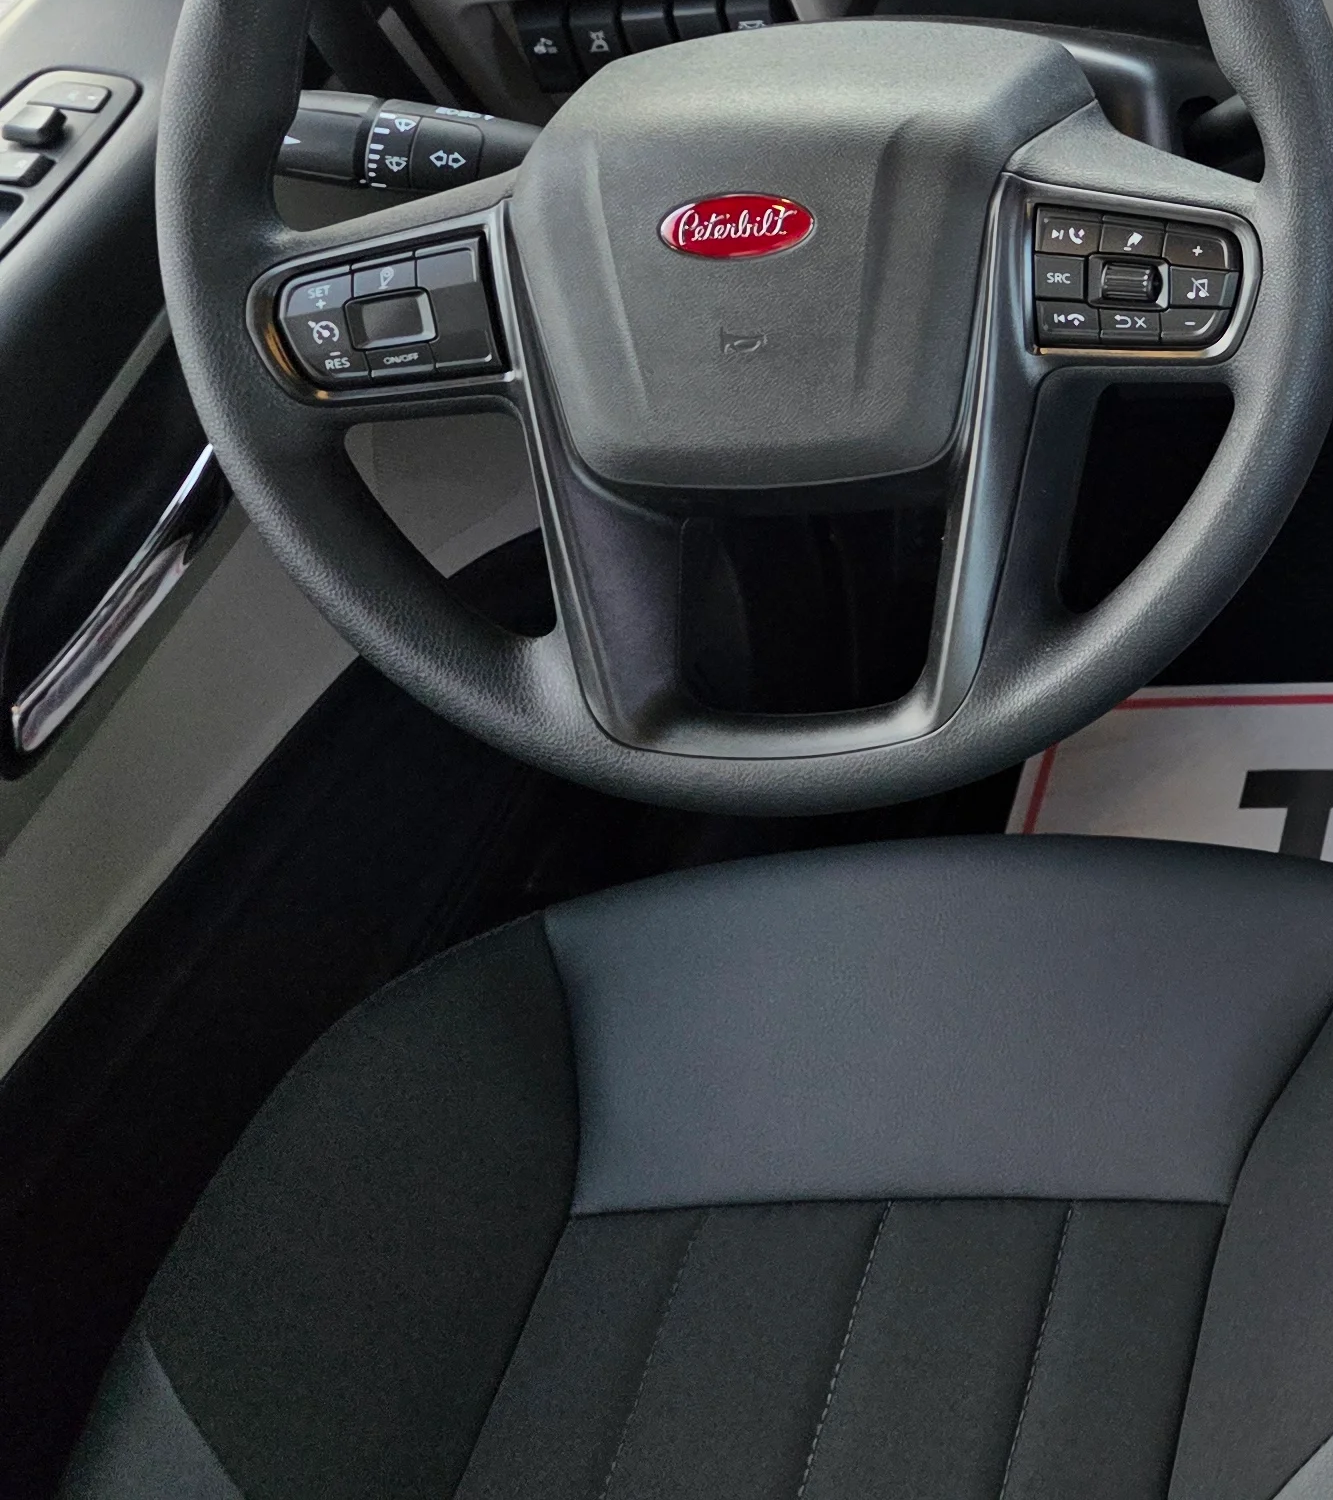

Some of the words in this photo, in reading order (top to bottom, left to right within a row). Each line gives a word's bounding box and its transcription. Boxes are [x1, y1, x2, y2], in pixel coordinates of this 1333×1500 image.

[678, 206, 797, 246] Peterbilt
[1046, 273, 1071, 284] SRC
[307, 285, 331, 299] SET
[325, 357, 350, 370] RES
[383, 352, 419, 365] ON/OFF
